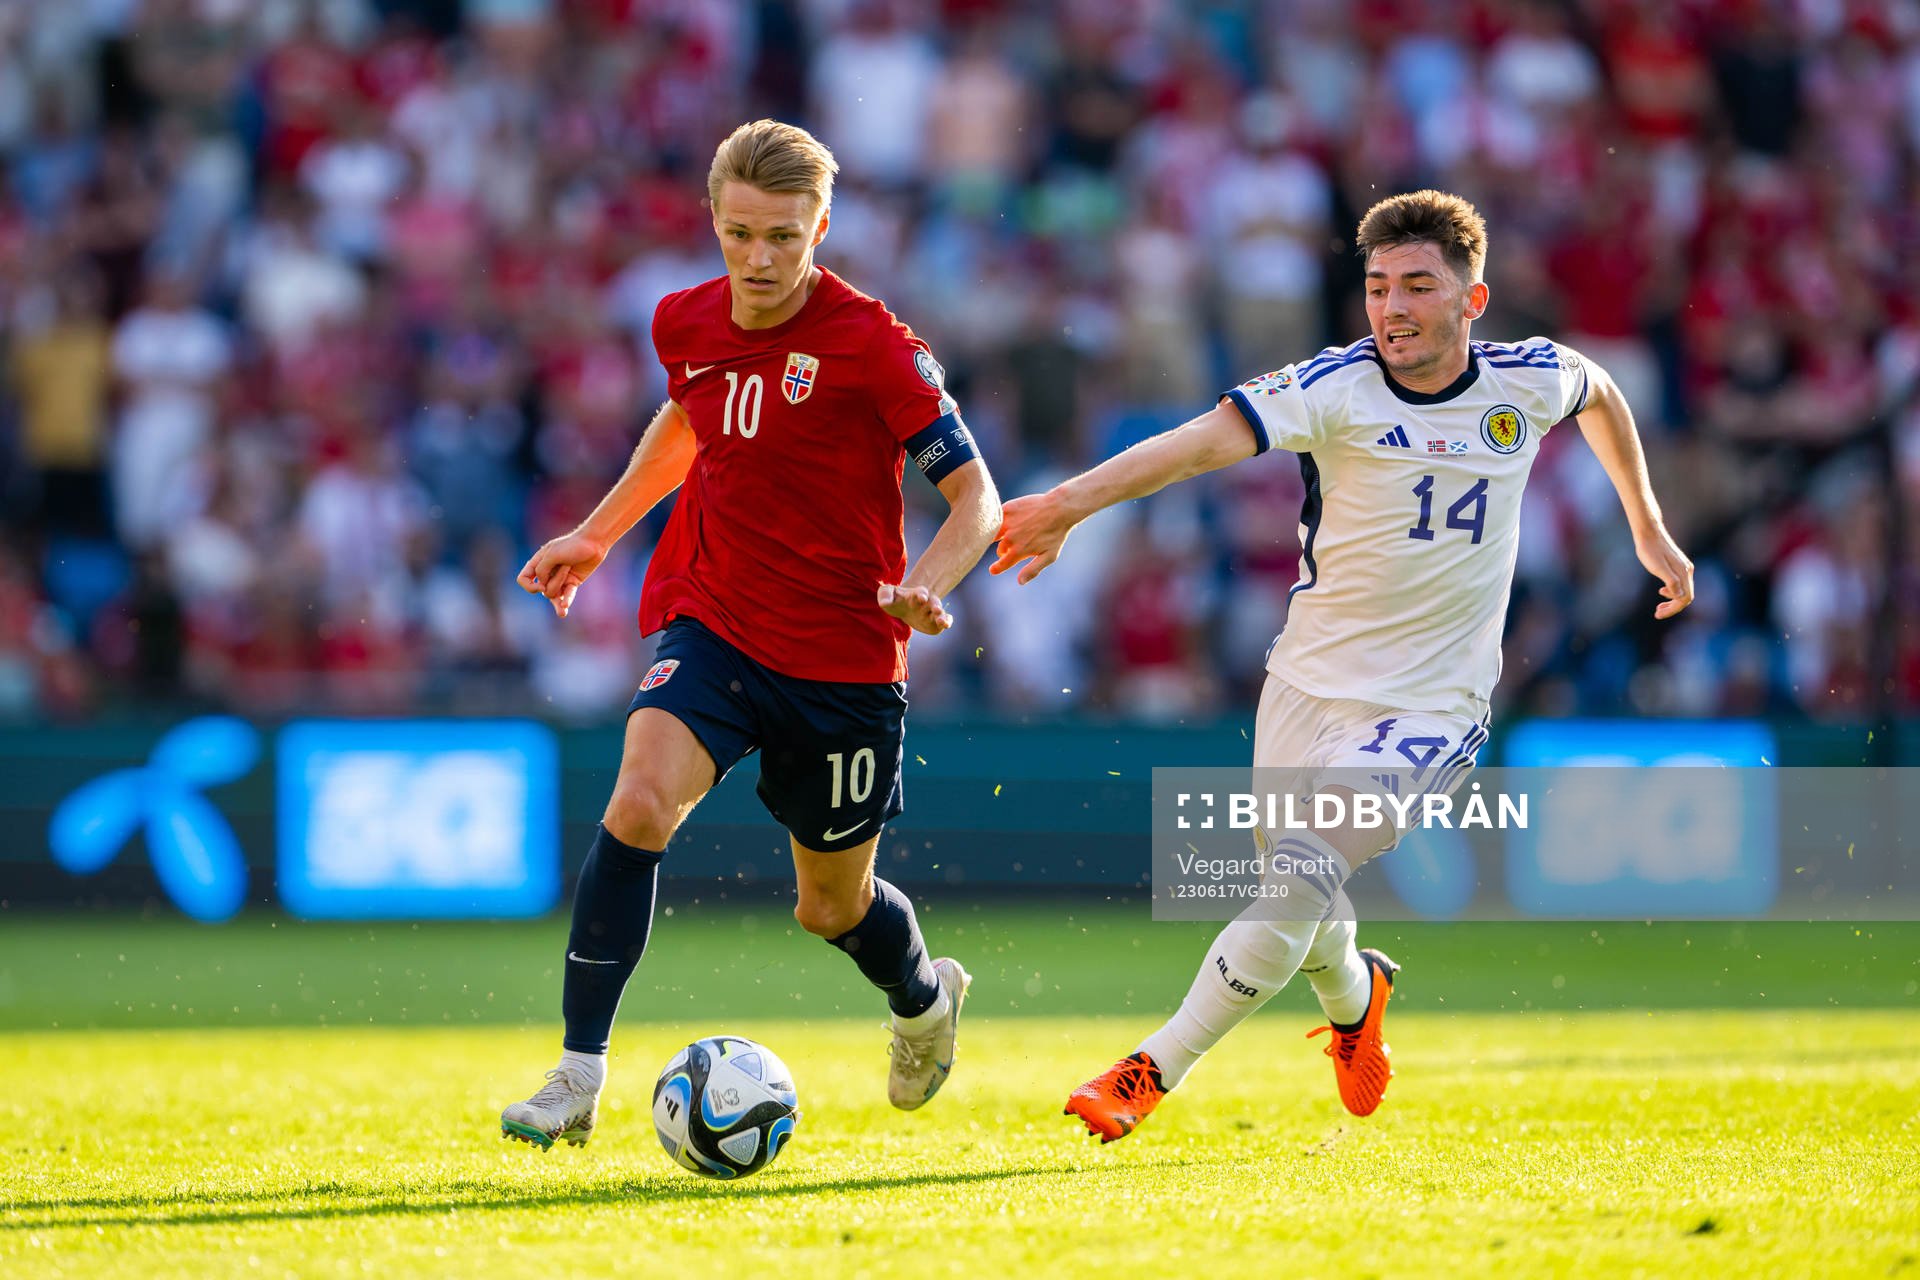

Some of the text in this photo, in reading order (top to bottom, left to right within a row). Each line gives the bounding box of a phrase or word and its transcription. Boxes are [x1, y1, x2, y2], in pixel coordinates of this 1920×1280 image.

[723, 371, 764, 439] 10
[1408, 475, 1489, 545] 14
[827, 747, 876, 808] 10
[1358, 718, 1450, 783] 14
[1216, 955, 1258, 998] ALBA
